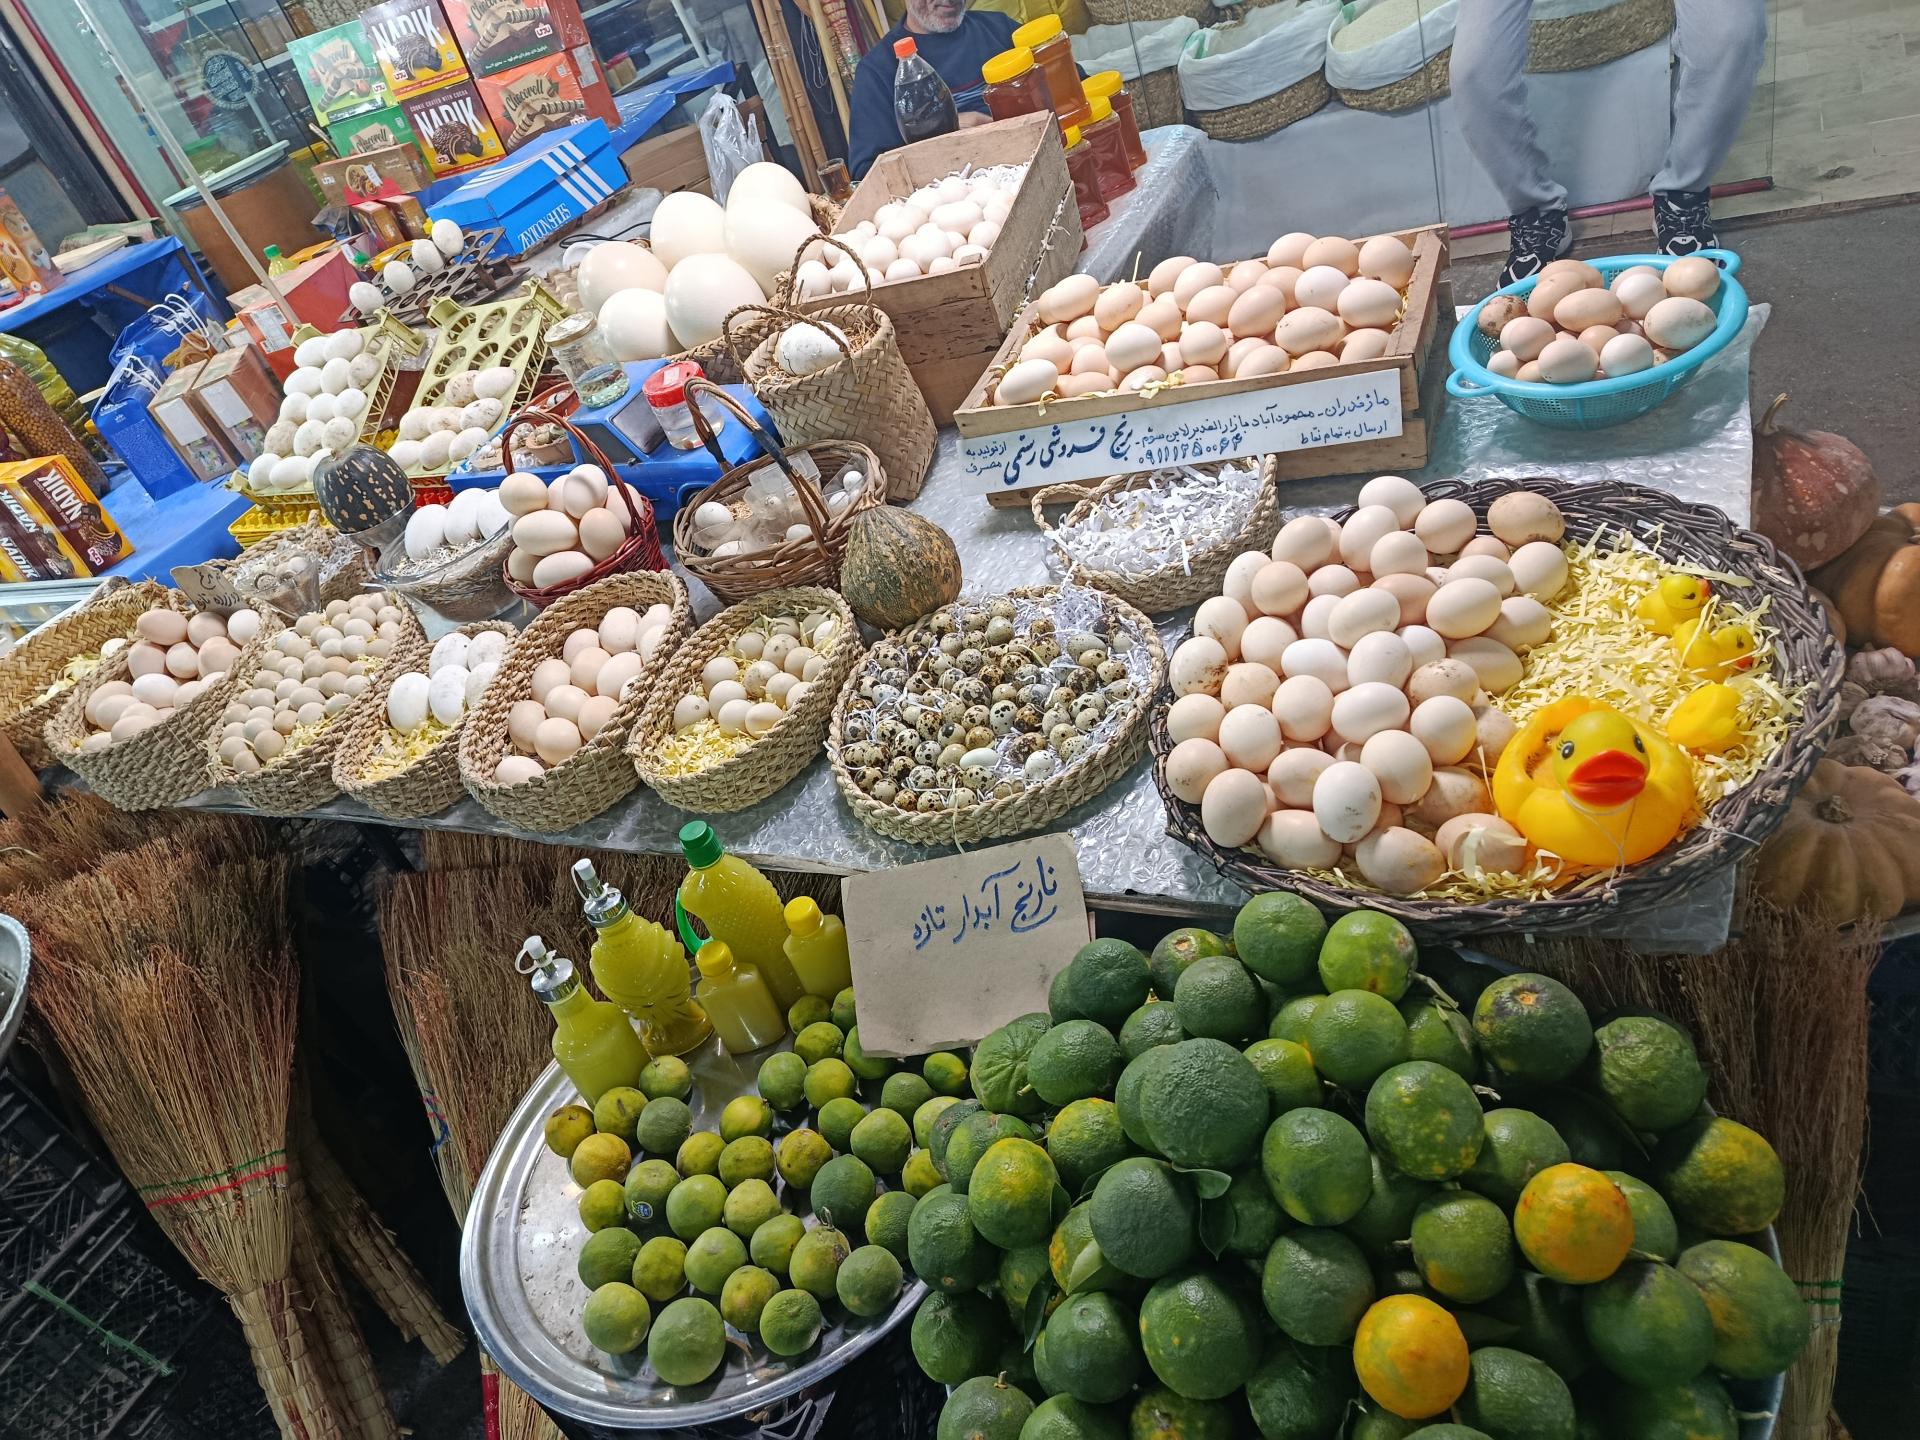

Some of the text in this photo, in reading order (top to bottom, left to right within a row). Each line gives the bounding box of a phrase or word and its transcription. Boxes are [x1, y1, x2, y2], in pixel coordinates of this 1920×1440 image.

[414, 97, 487, 148] NADIK
[0, 489, 39, 533] NADIK
[37, 468, 83, 521] NADIK
[0, 537, 39, 578] NADIK
[912, 855, 1059, 951] نارنج آبدار تازه
